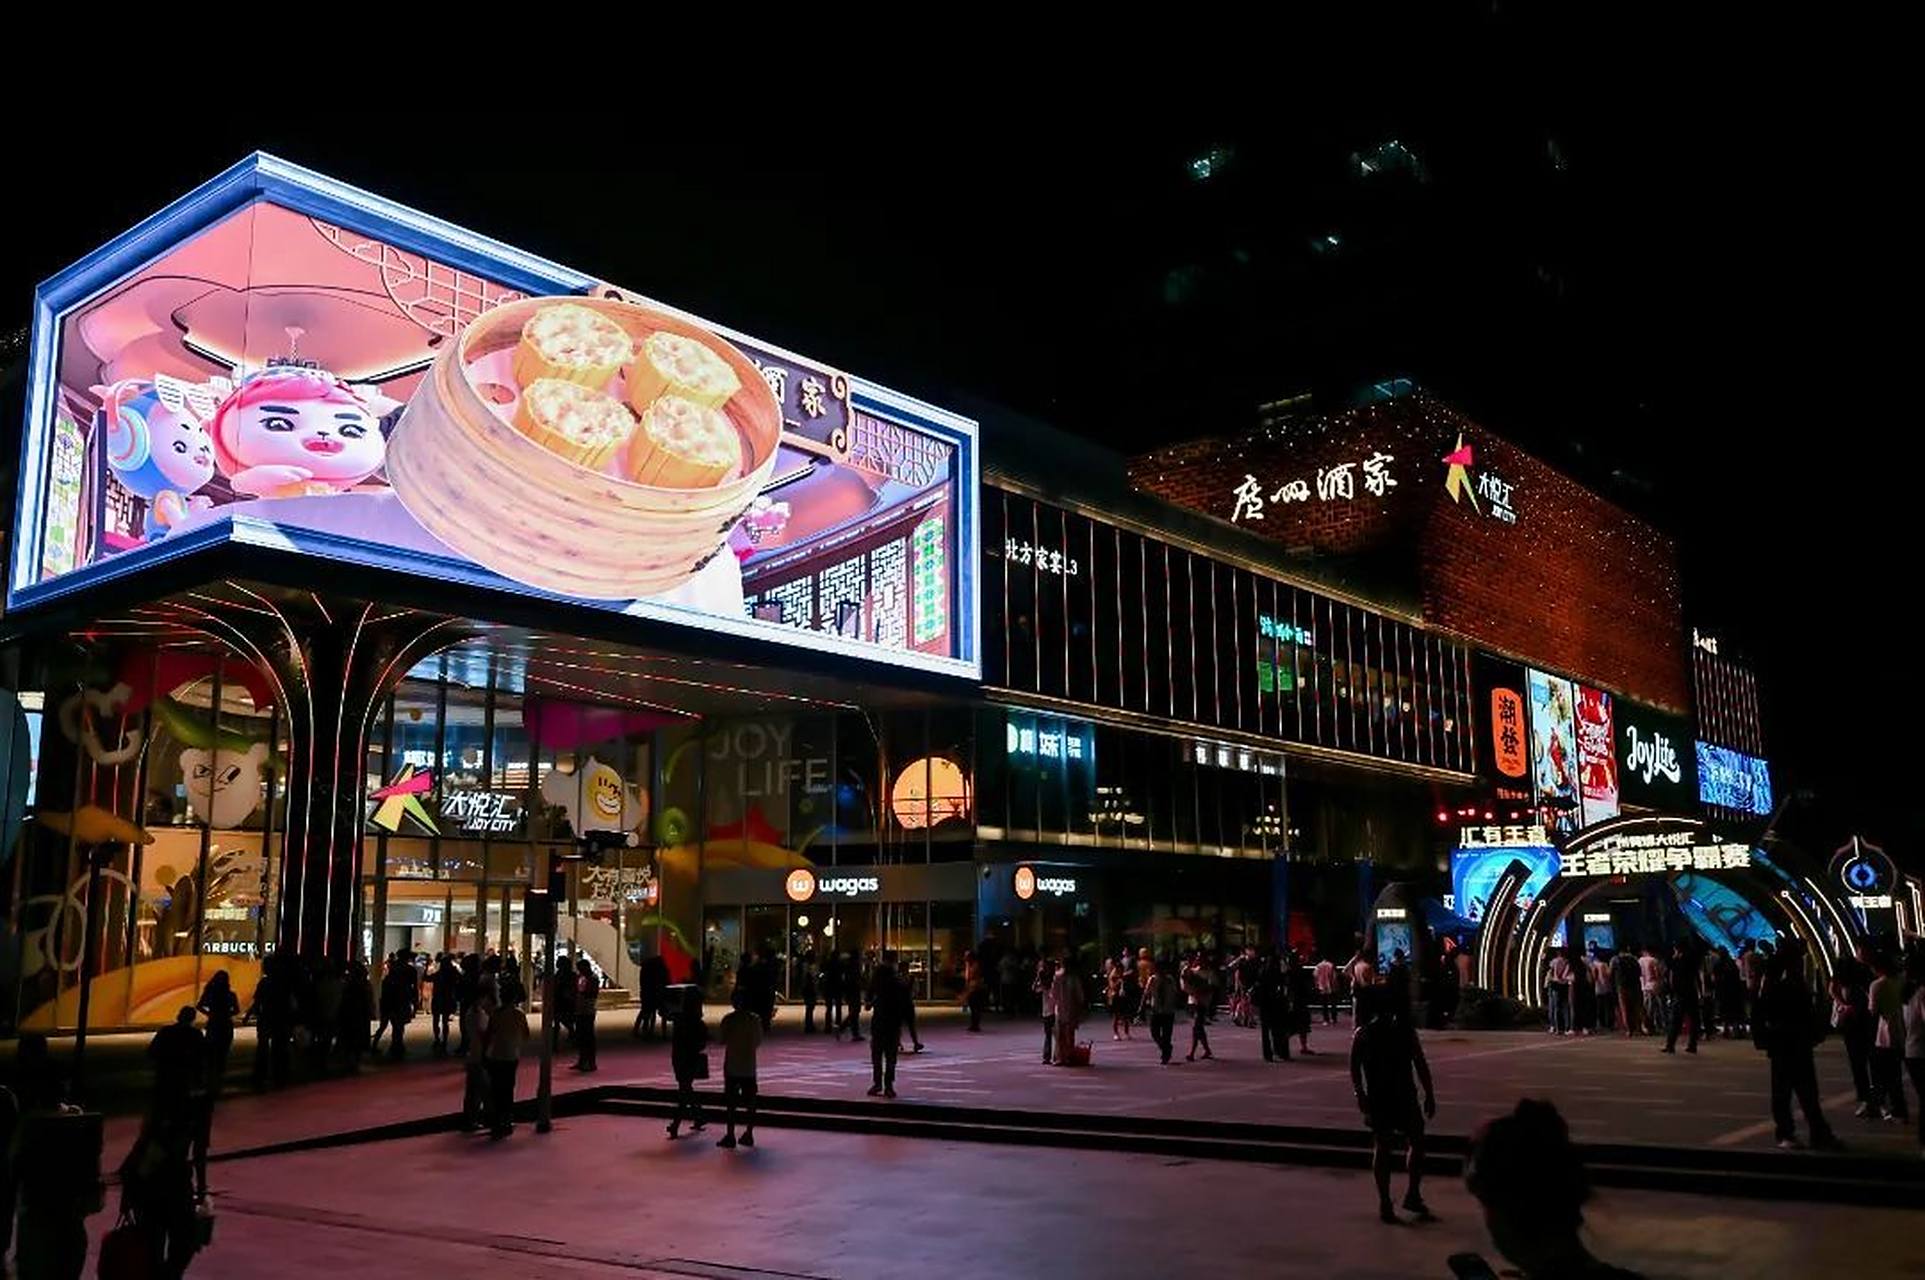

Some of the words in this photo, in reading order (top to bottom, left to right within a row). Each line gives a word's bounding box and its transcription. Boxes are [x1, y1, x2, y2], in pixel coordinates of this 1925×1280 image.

[711, 722, 796, 760] JOY
[738, 758, 829, 797] LIFE
[443, 790, 516, 819] 大悦汇
[491, 819, 517, 832] CITY
[1560, 843, 1751, 877] 王者荣耀争霸赛
[819, 878, 879, 897] wagas
[1036, 878, 1075, 896] wagas
